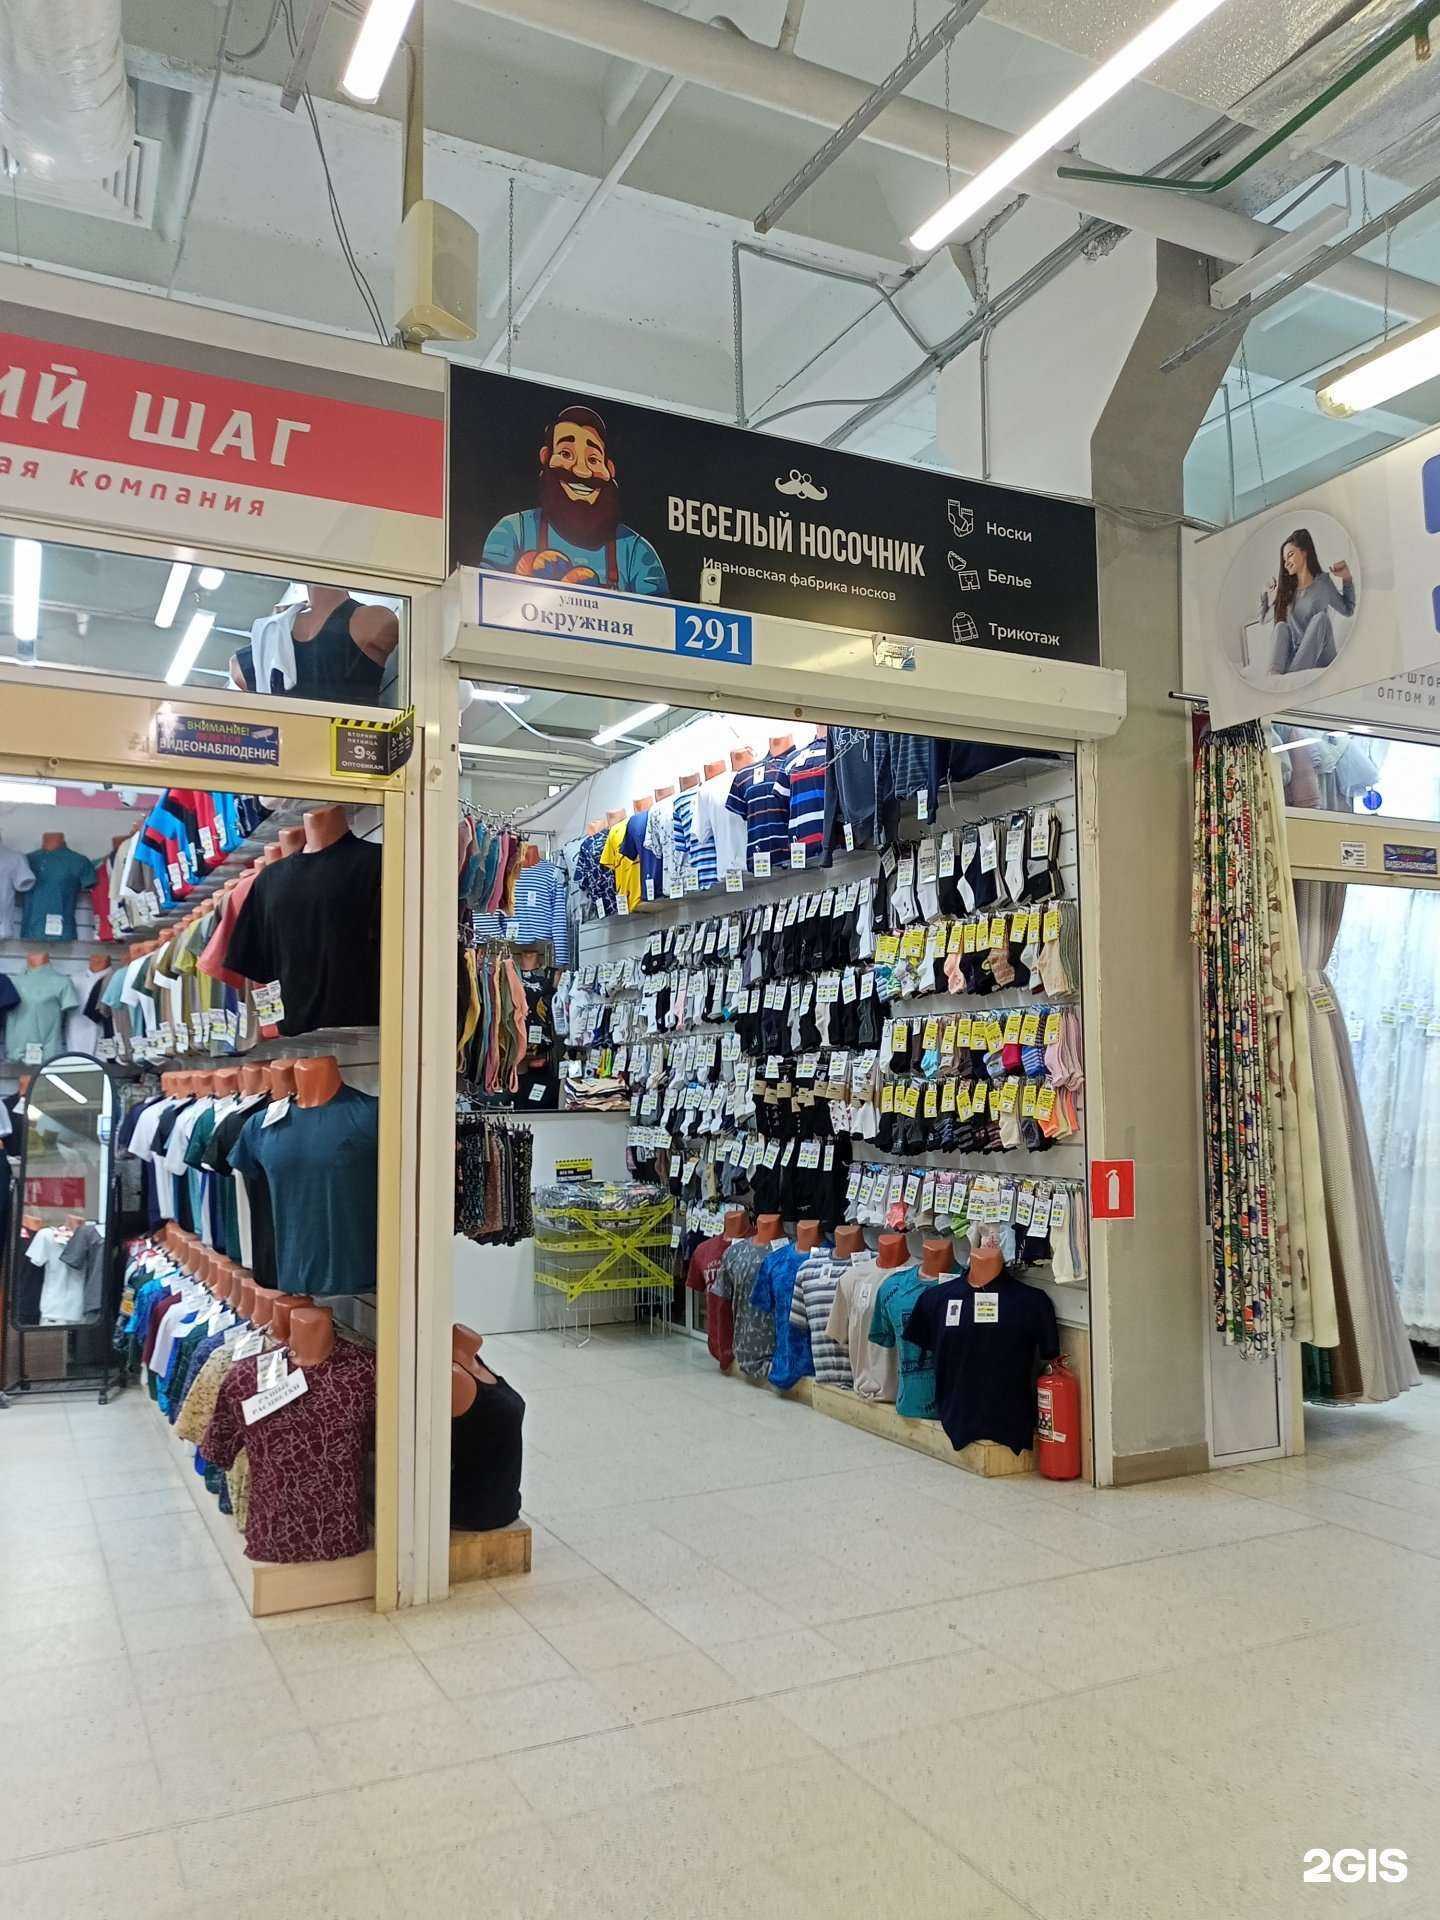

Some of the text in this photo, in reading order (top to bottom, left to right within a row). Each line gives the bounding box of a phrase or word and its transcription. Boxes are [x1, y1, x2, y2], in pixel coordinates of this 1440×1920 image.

[128, 391, 311, 467] ШАГ
[69, 468, 265, 516] компания
[668, 495, 926, 577] ВЕСЕЛЫЙ НОСОЧНИК
[986, 521, 1032, 542] Носки
[703, 557, 896, 601] Ивановская фабрика носков
[988, 569, 1033, 588] Белье
[559, 594, 599, 609] улица
[521, 603, 743, 656] Окружная 291
[988, 623, 1060, 646] Трикотаж
[1378, 686, 1421, 704] ОПТОМ
[186, 720, 250, 738] ВНИМАНИЕ!
[160, 736, 277, 760] ВИДЕОНАБЛЮДЕНИЕ
[348, 745, 377, 761] -9%
